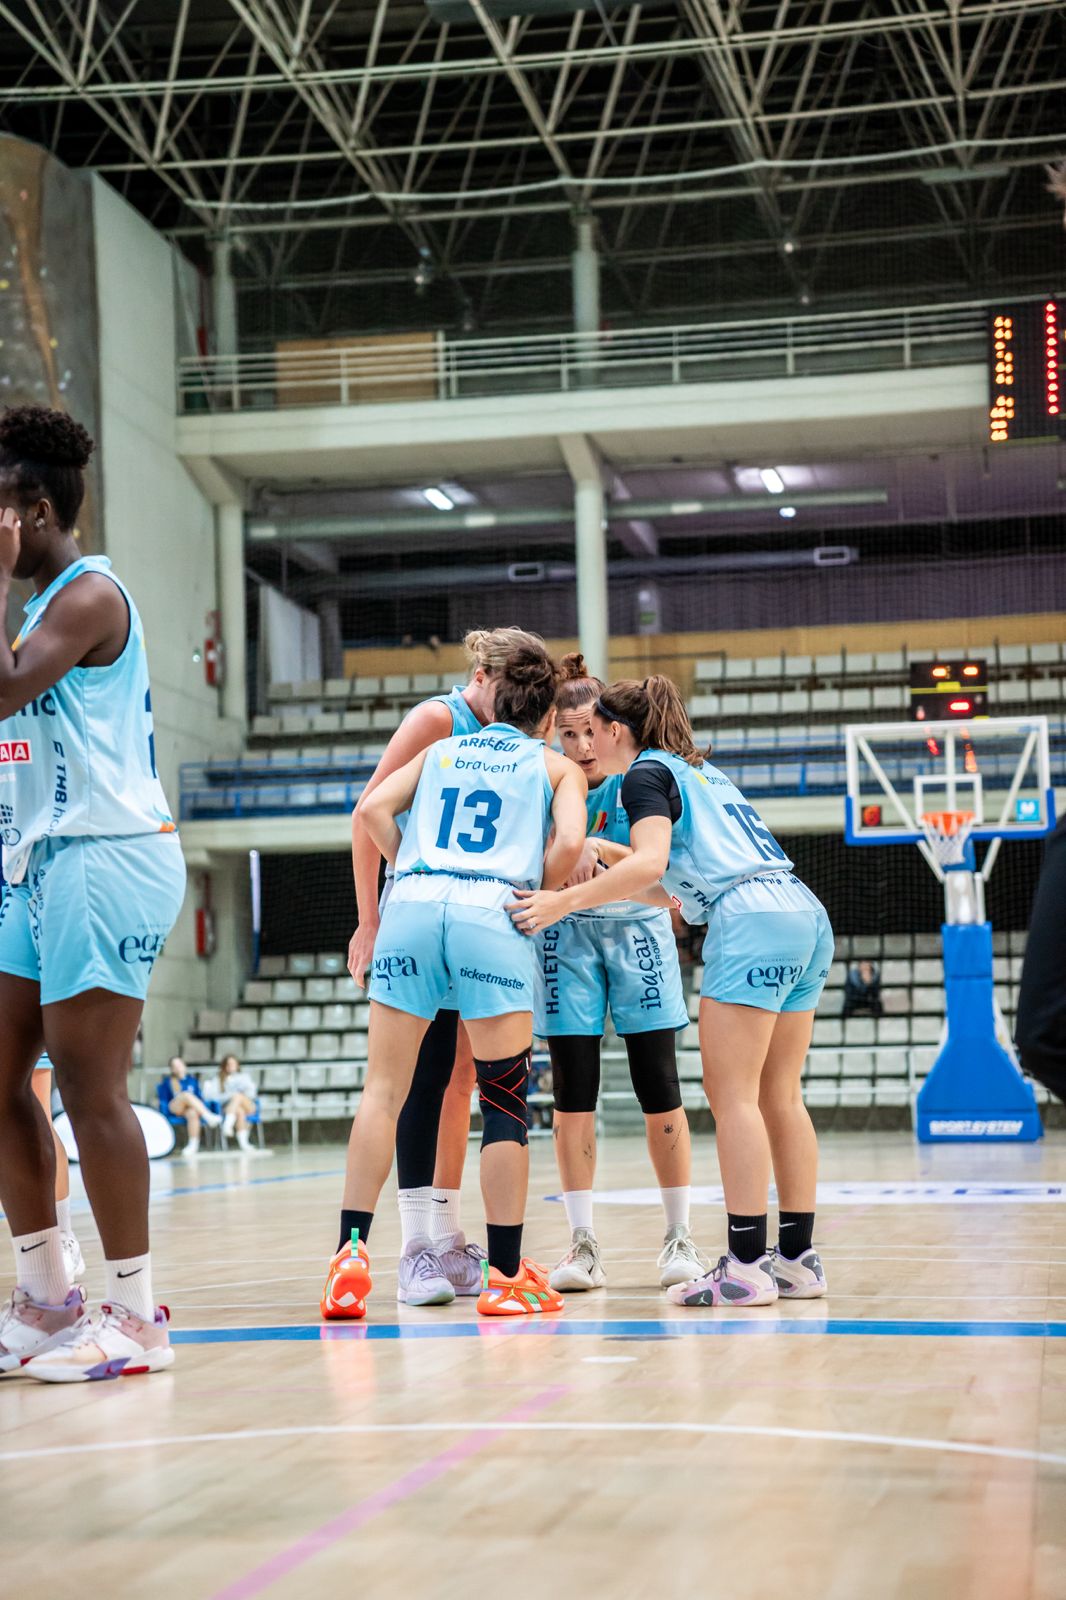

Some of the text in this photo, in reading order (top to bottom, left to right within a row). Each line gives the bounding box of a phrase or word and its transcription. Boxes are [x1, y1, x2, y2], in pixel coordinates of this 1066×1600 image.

[458, 737, 520, 752] ARREGUI
[455, 757, 518, 773] bravent
[54, 764, 68, 803] THB
[435, 787, 502, 853] 13
[722, 803, 786, 862] 15
[650, 936, 663, 967] GROUP
[460, 966, 525, 990] ticketmaster
[632, 935, 662, 1010] ibacar
